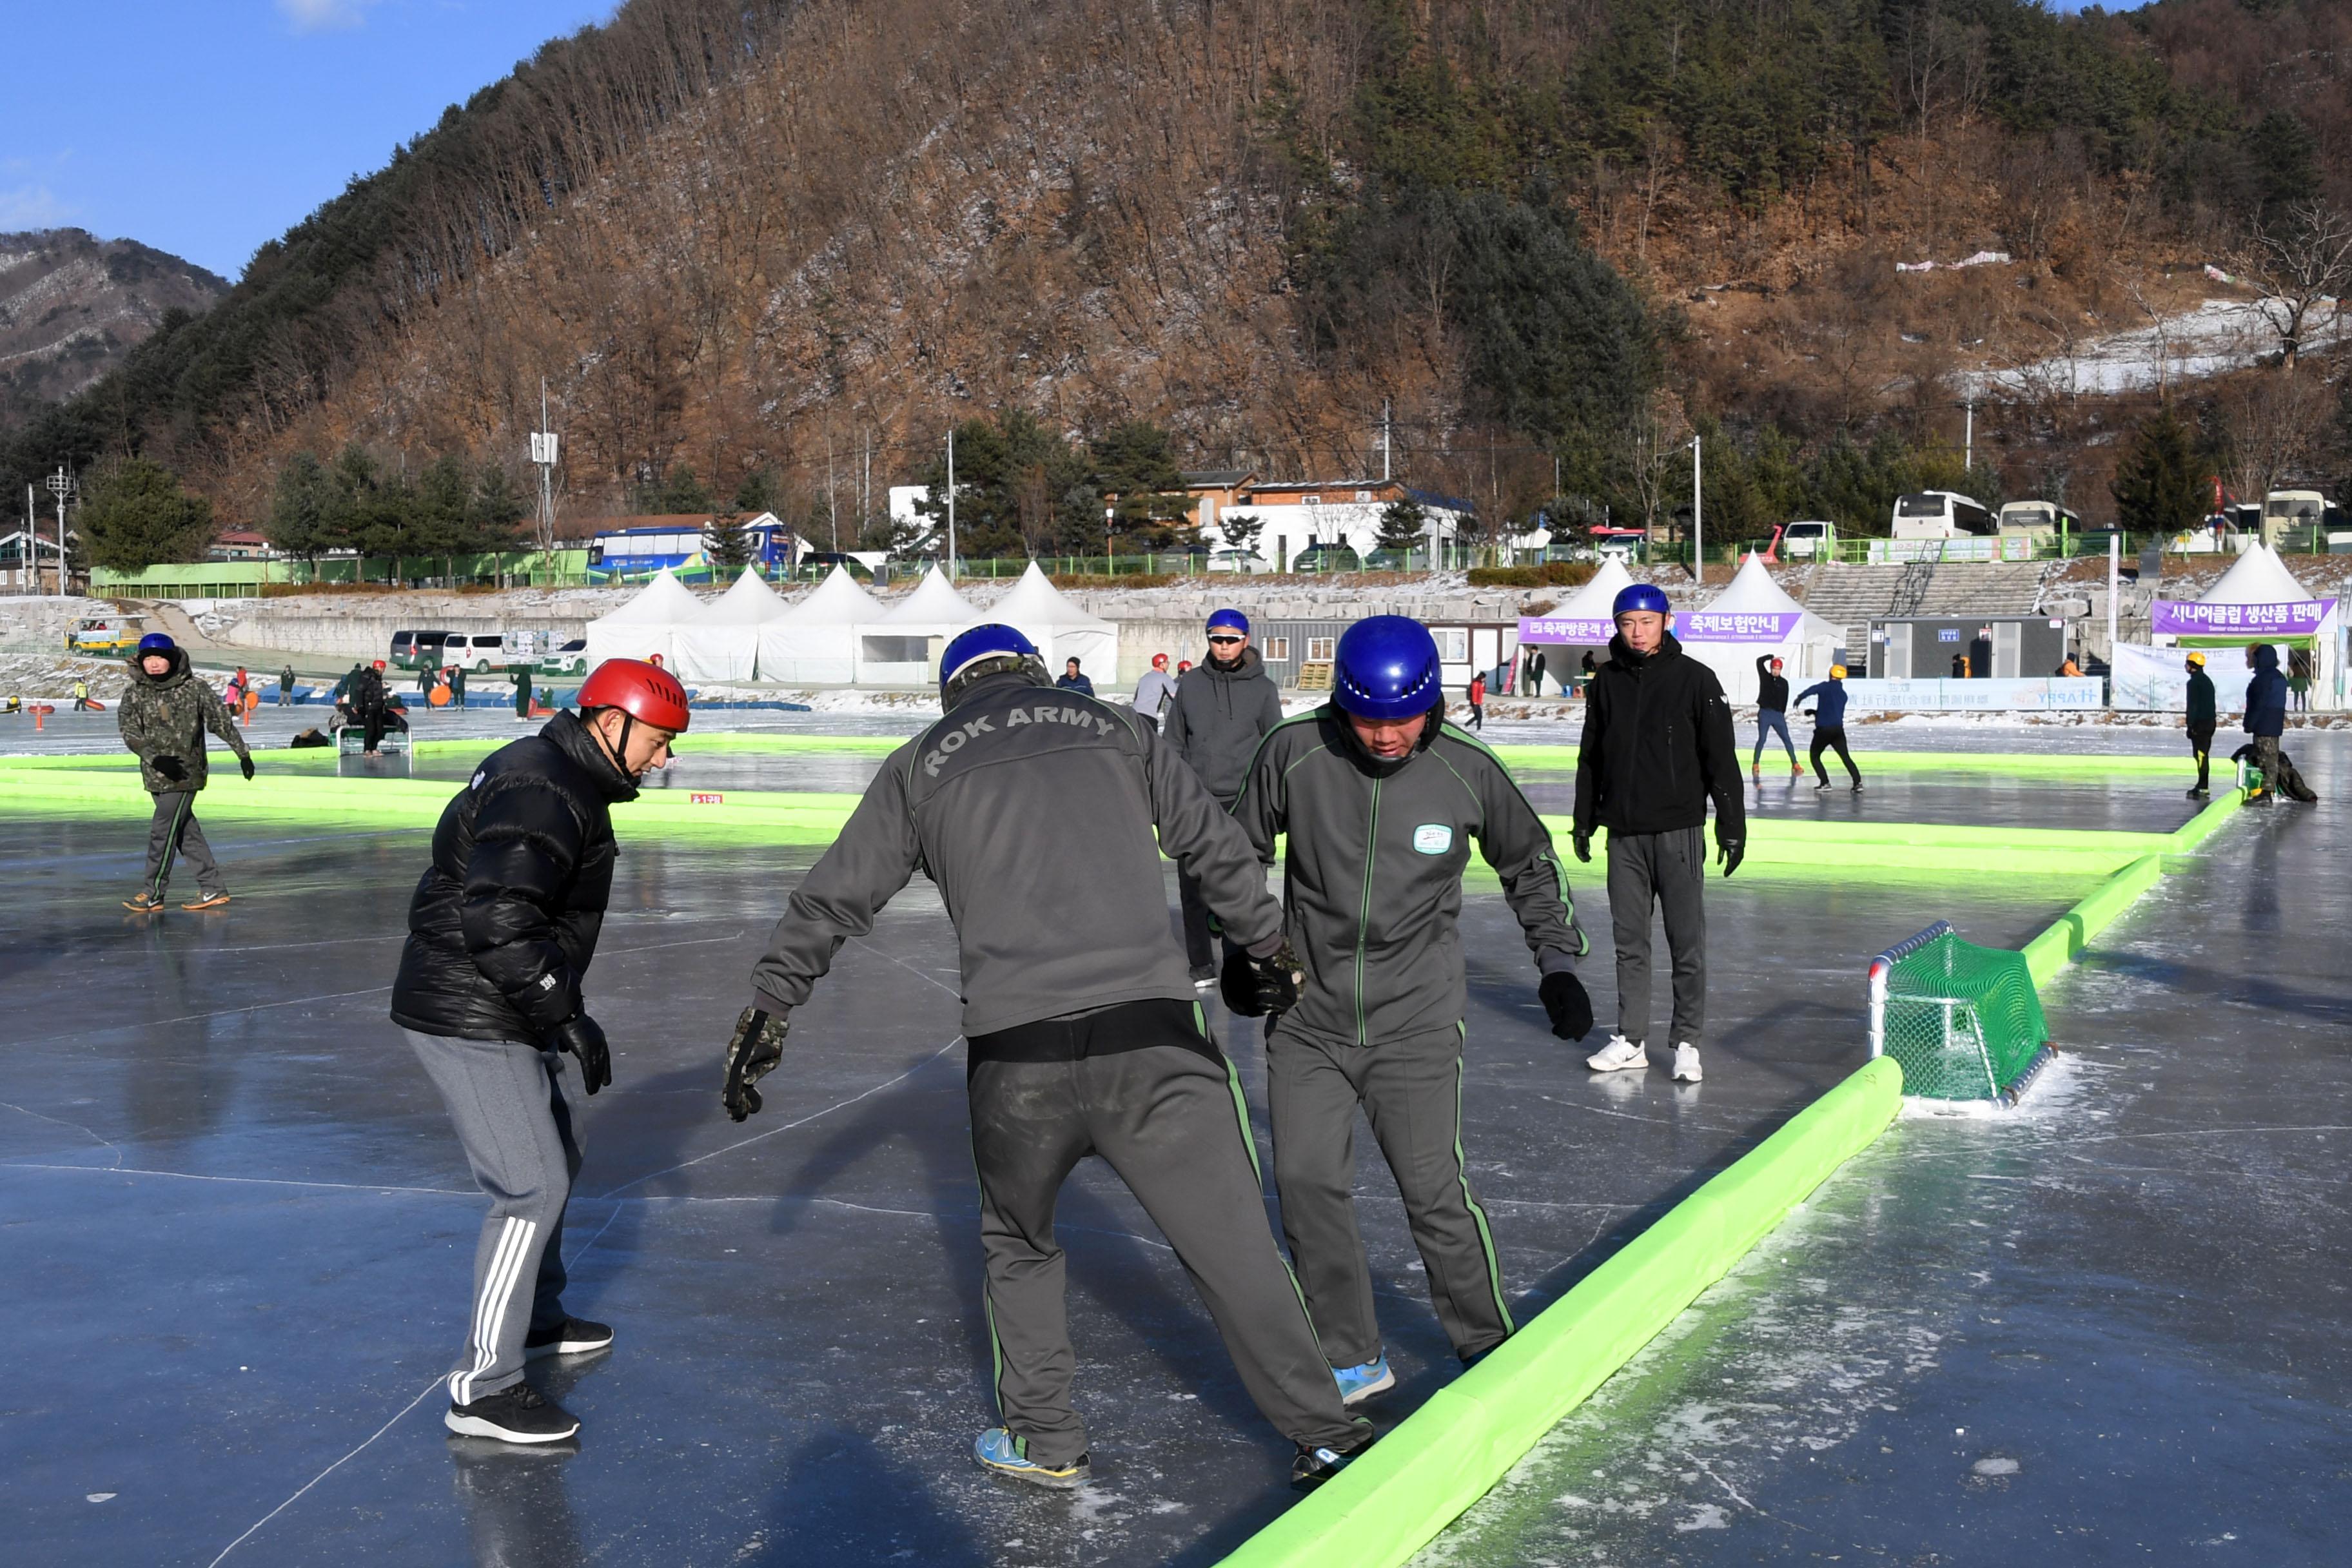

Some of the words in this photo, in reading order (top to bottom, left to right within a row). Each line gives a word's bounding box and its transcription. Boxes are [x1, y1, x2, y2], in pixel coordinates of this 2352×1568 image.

[2171, 605, 2241, 624] 시니어클럽
[2246, 604, 2288, 624] 생산품
[2292, 603, 2322, 622] 판매
[1543, 622, 1601, 637] 축제방문객
[1603, 623, 1618, 637] 설
[1689, 614, 1779, 634] 축제보험안내
[924, 715, 996, 777] ROK
[1006, 707, 1115, 736] ARMY
